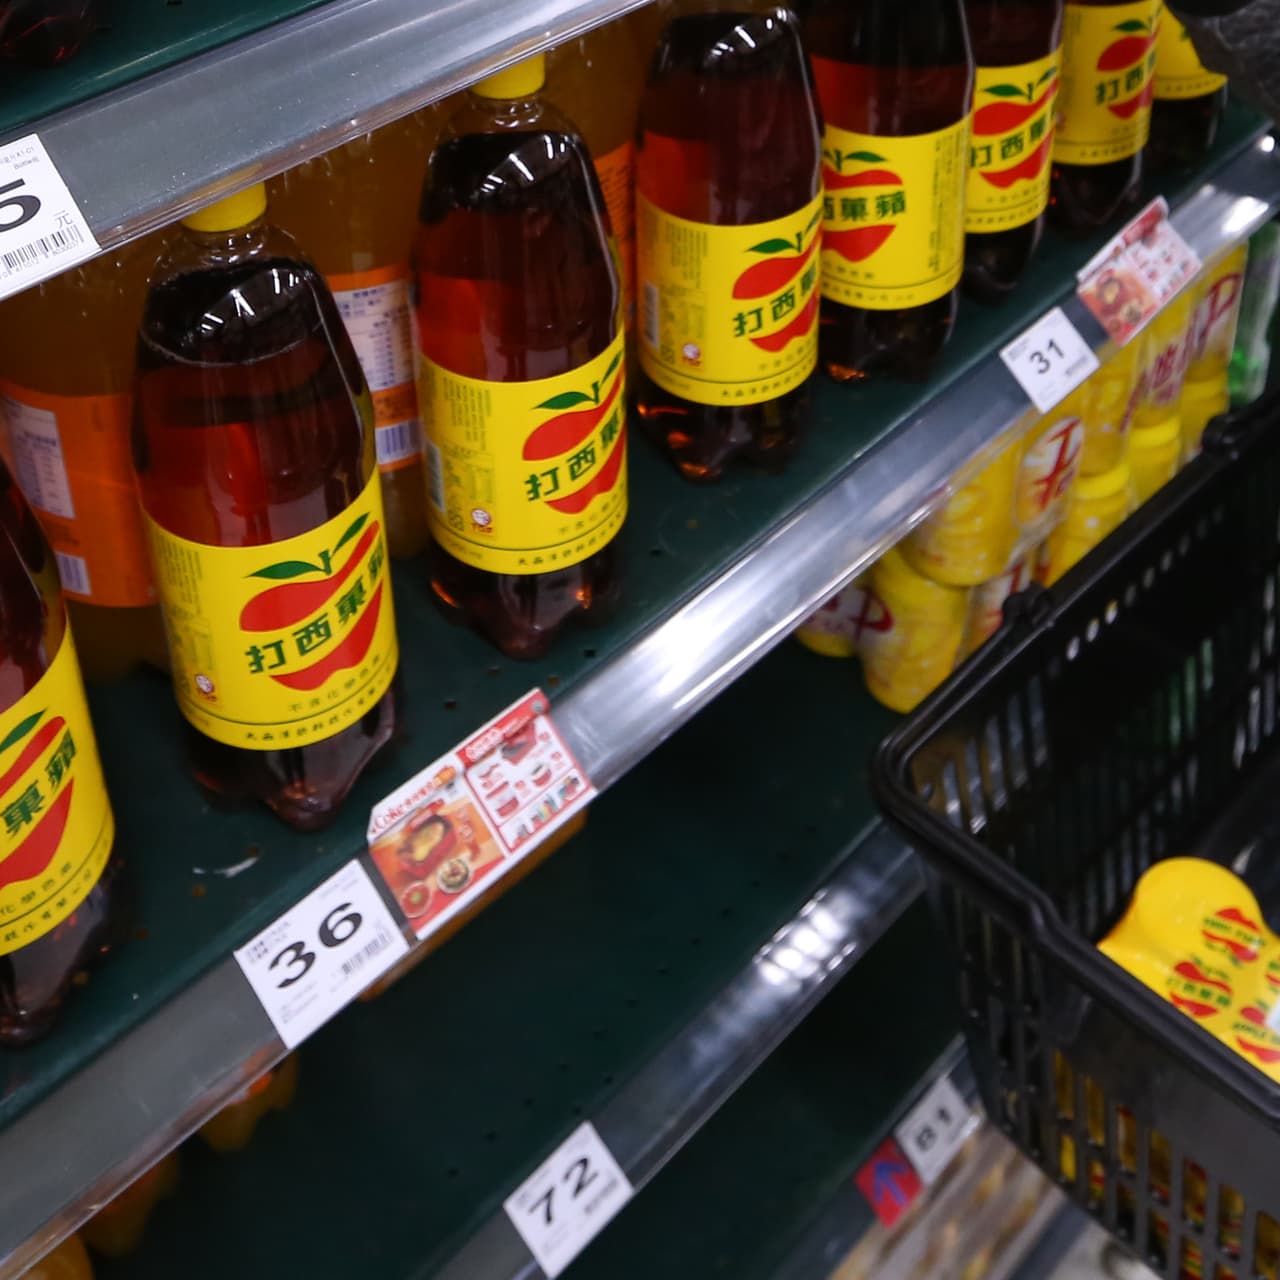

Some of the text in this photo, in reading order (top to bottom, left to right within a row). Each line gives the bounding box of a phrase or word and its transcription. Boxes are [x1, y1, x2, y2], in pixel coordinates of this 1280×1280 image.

[53, 210, 73, 229] 元
[1029, 338, 1065, 375] 31
[268, 901, 363, 989] 36
[529, 1156, 598, 1225] 72
